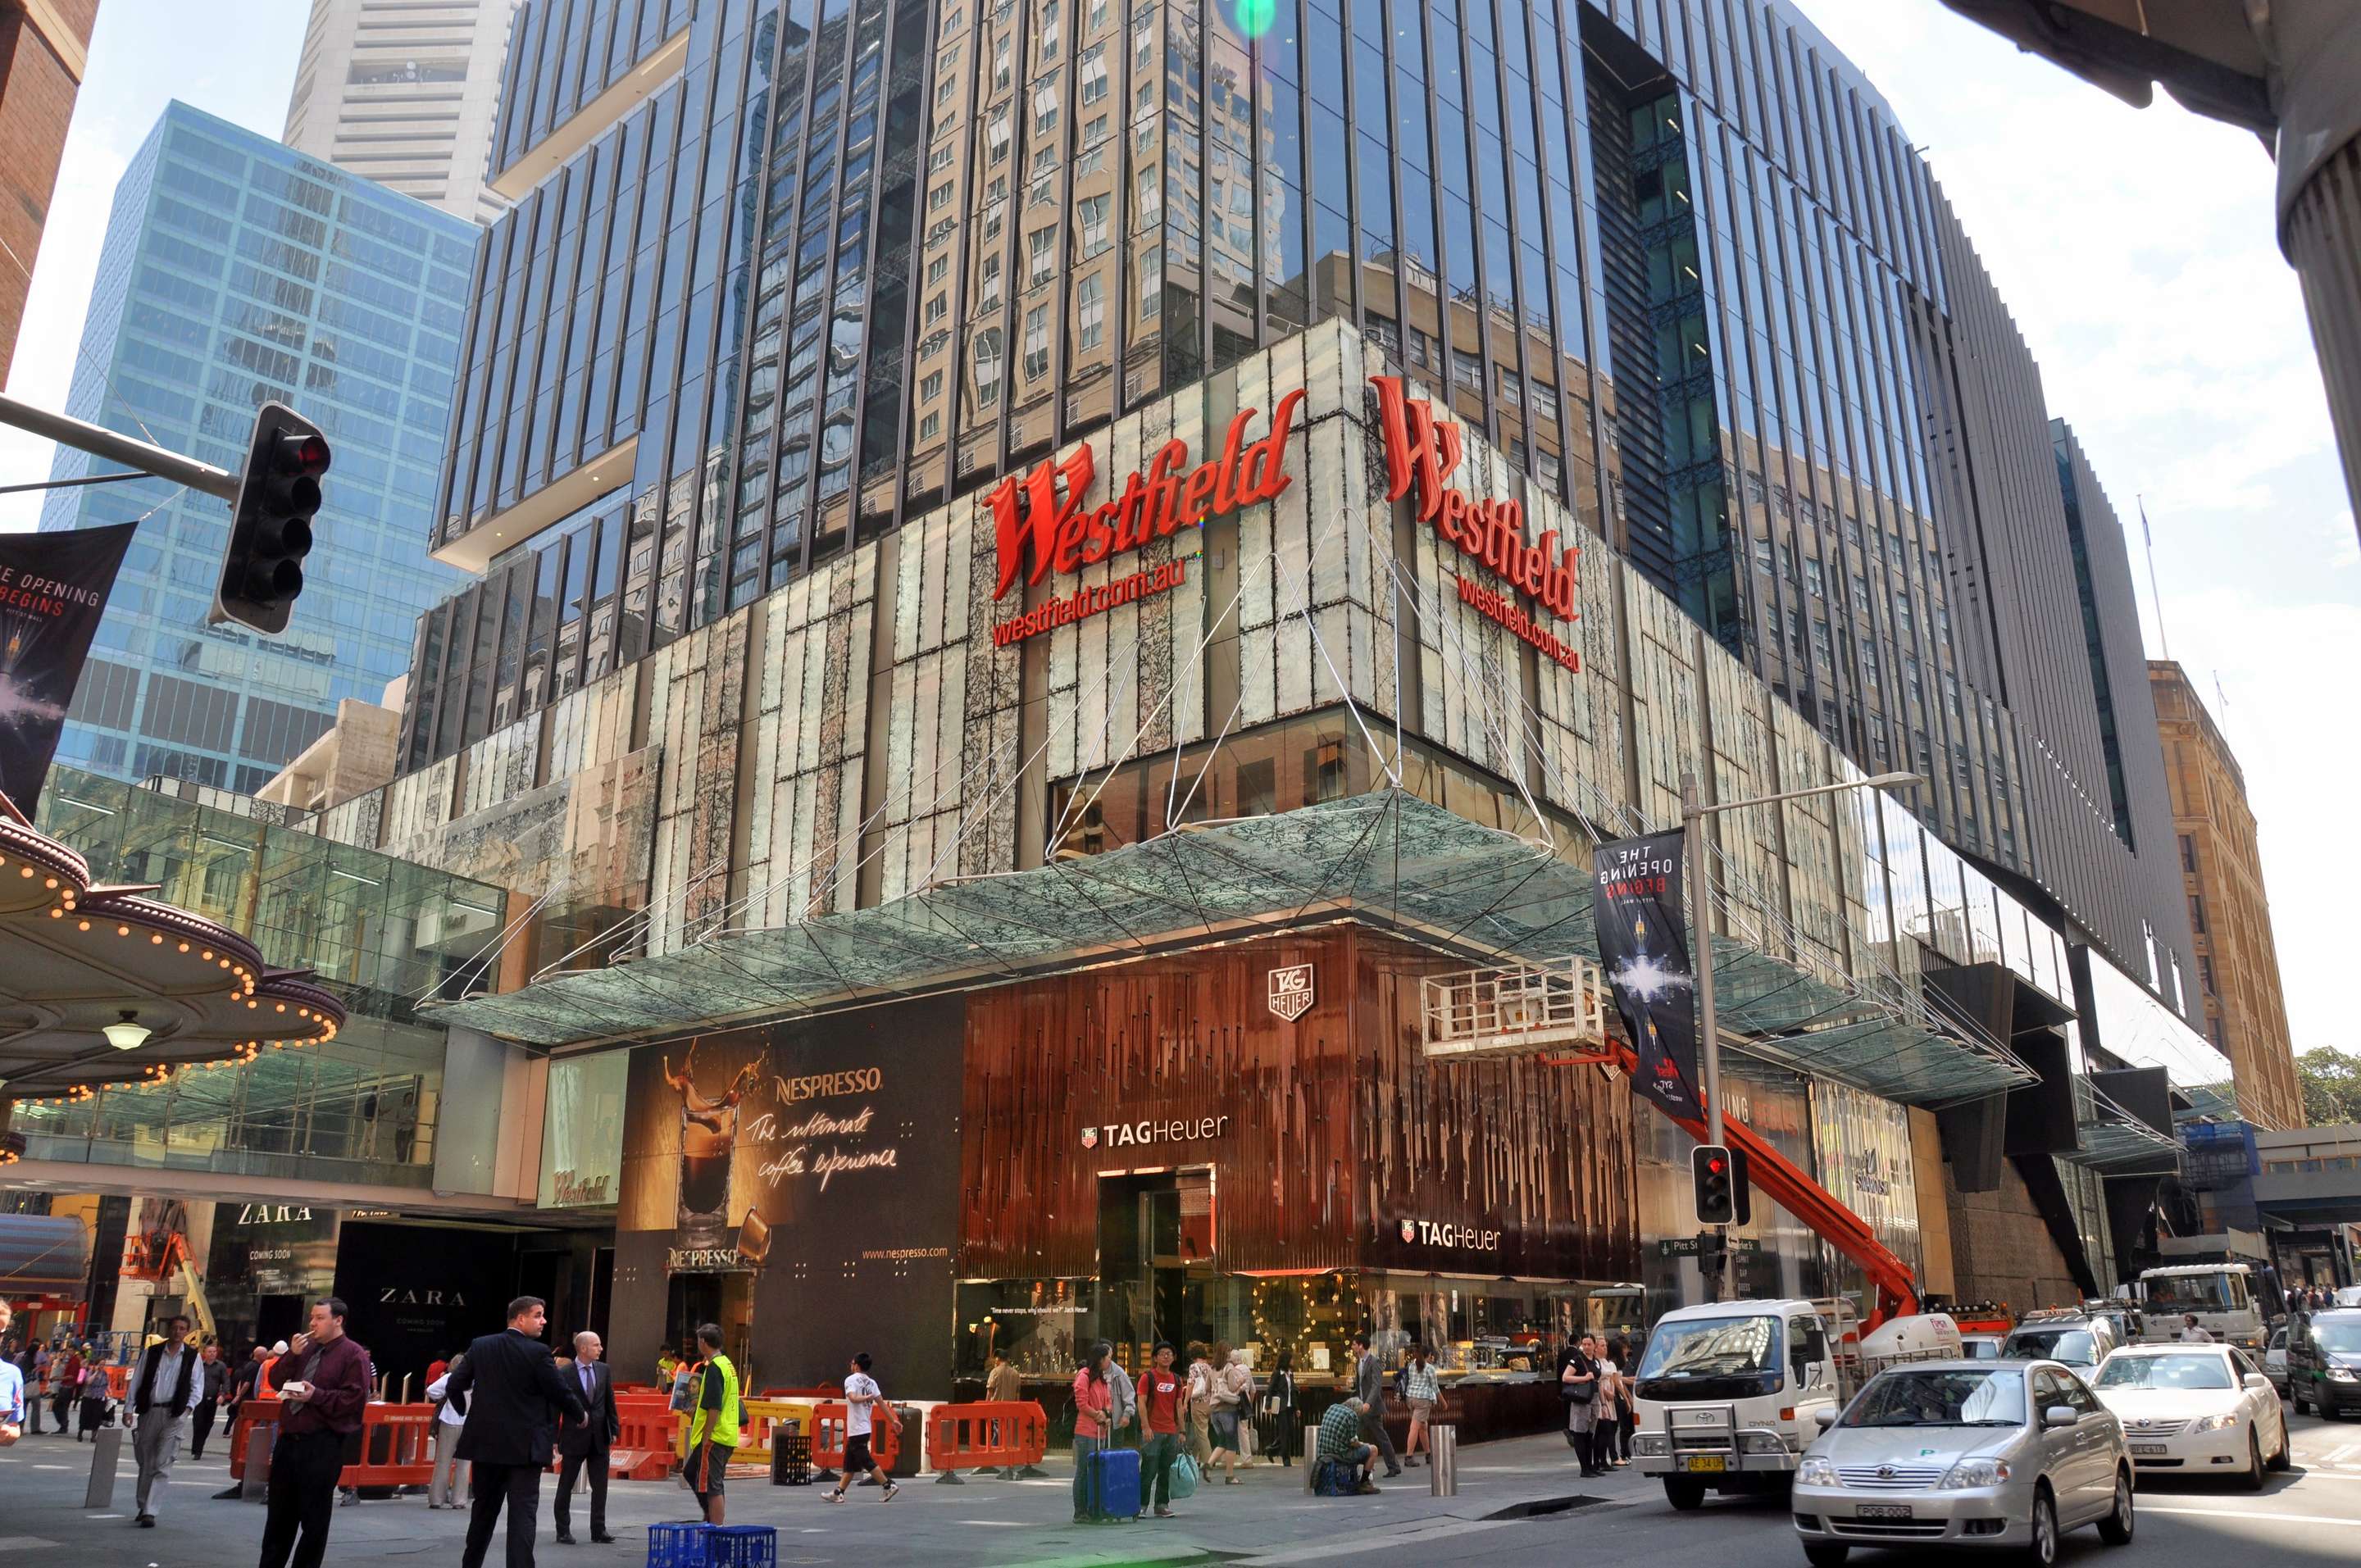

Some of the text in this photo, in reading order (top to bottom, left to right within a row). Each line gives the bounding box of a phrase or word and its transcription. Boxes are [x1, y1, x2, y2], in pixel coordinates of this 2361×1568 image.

[984, 388, 1308, 602] Westfield
[1368, 375, 1581, 623] Westfield
[0, 585, 64, 616] BEGINS
[20, 574, 99, 607] OPENING
[993, 557, 1185, 648] westfield.com.au
[1457, 575, 1581, 674] westfield.com.au
[1276, 969, 1306, 993] TAG
[1272, 993, 1310, 1016] HEUER
[773, 1067, 881, 1106] NESPRESSO
[746, 1107, 875, 1142] The ultimate
[758, 1146, 898, 1192] coffee experience
[238, 1202, 312, 1225] ZARA
[250, 1250, 291, 1261] COMING SOON
[862, 1248, 948, 1261] www.nespresso.com
[1674, 1241, 1689, 1251] Pitt
[380, 1288, 466, 1307] ZARA
